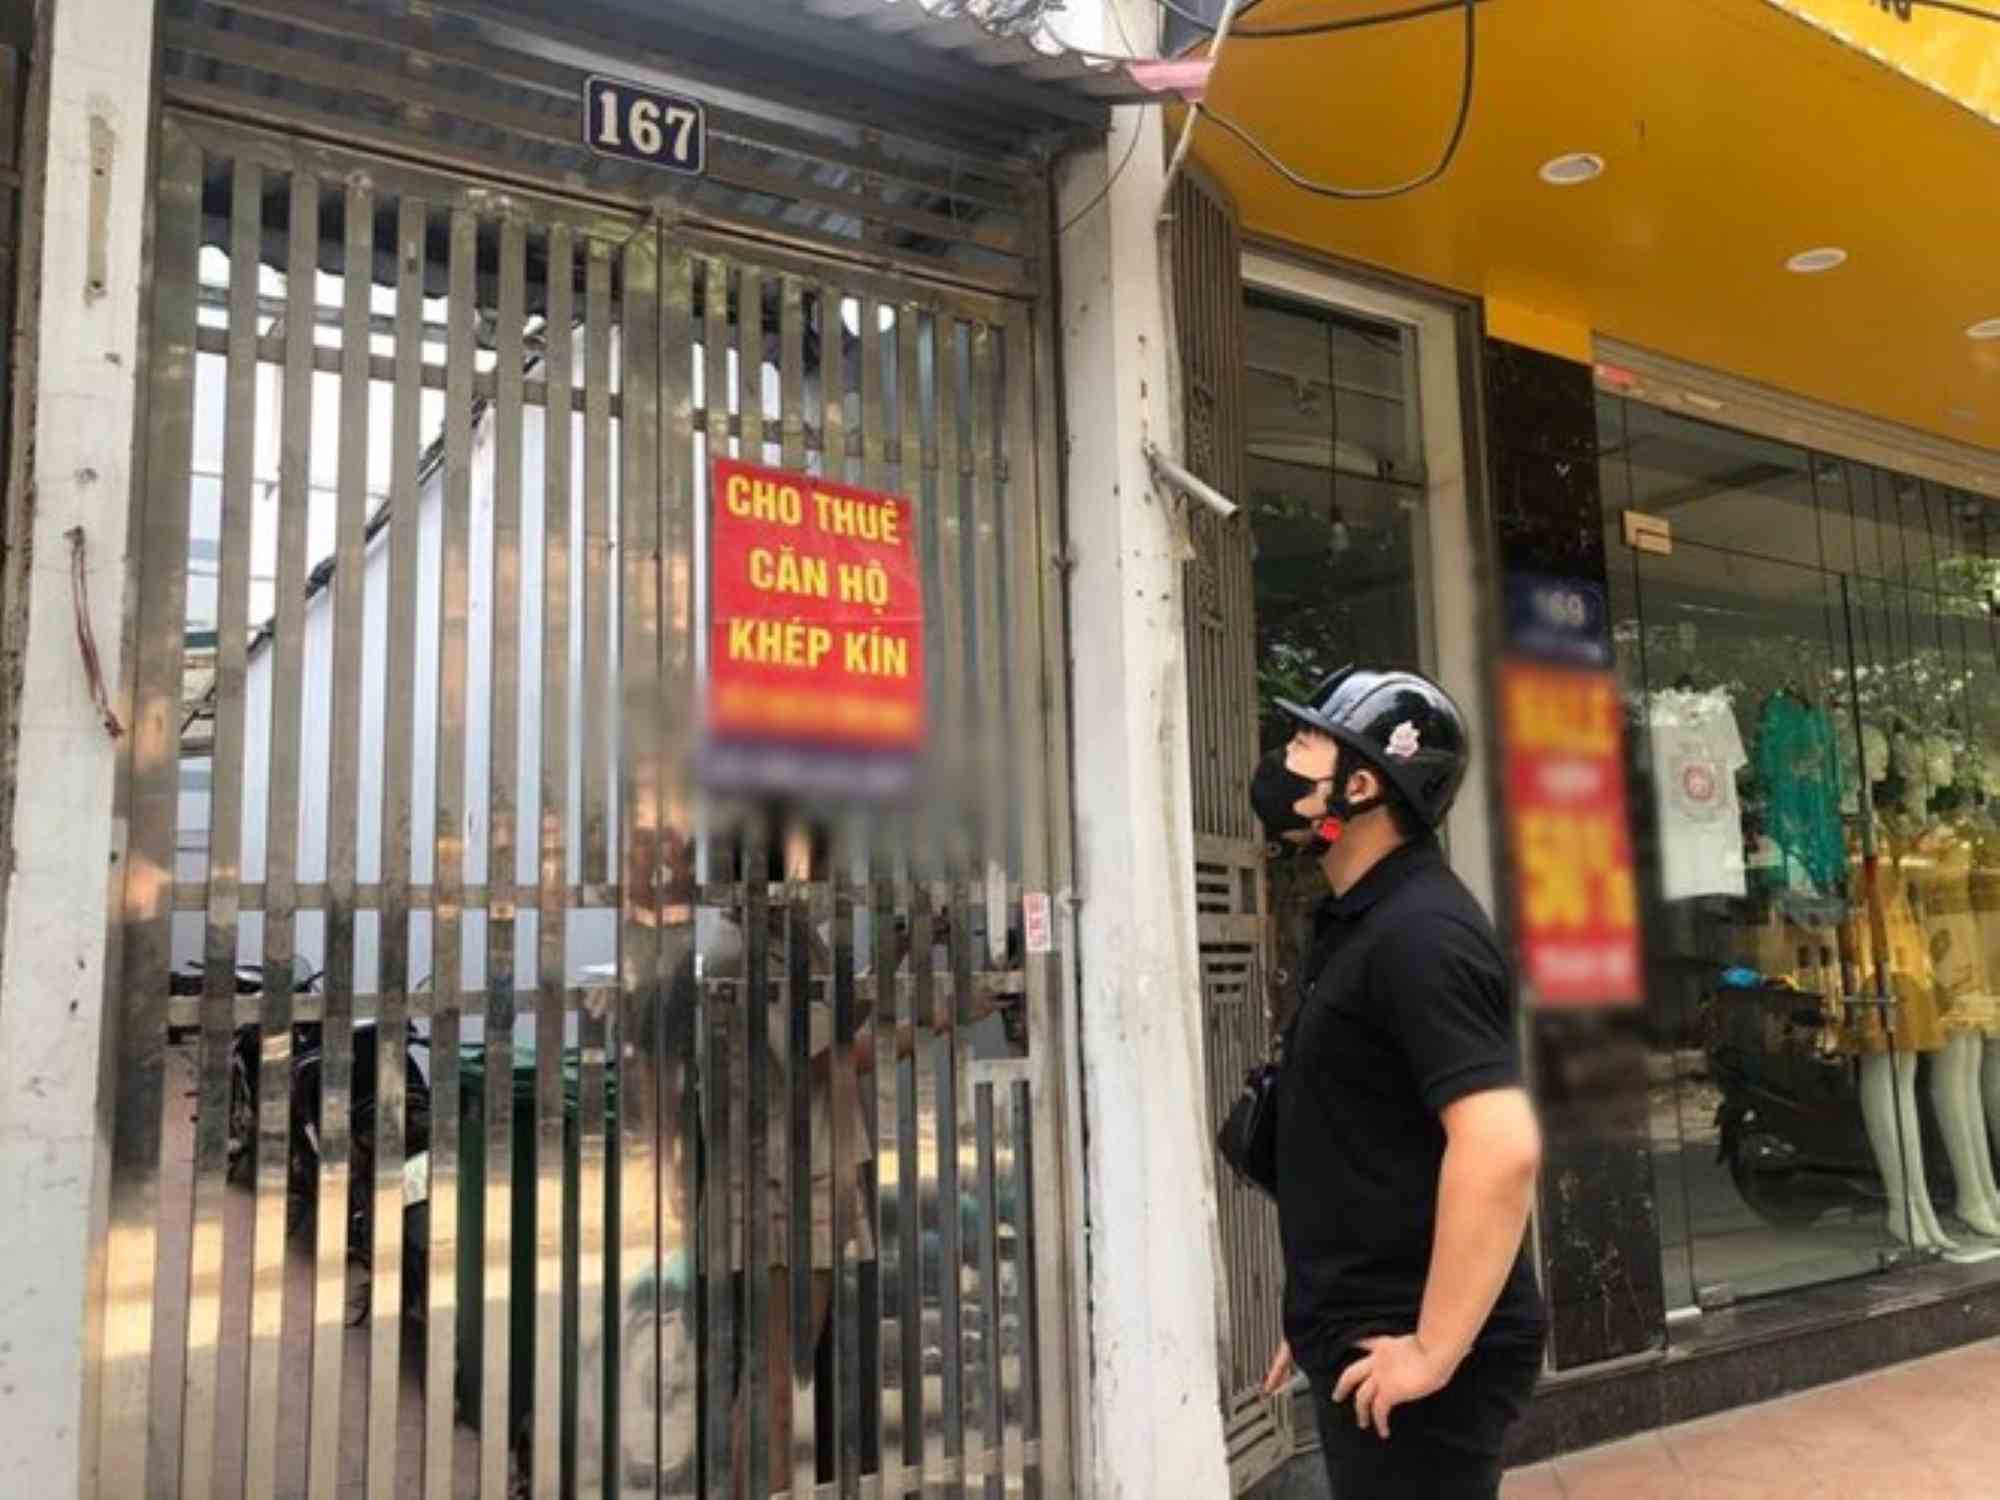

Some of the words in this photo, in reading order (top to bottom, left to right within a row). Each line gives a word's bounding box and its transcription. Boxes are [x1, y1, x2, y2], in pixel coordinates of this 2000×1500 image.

[598, 90, 696, 161] 167
[727, 474, 802, 526] CHO
[812, 491, 901, 544] THUÊ
[749, 543, 829, 598] CĂN
[838, 559, 888, 615] HỘ
[728, 616, 832, 668] KHÉP
[844, 626, 908, 677] KÍN
